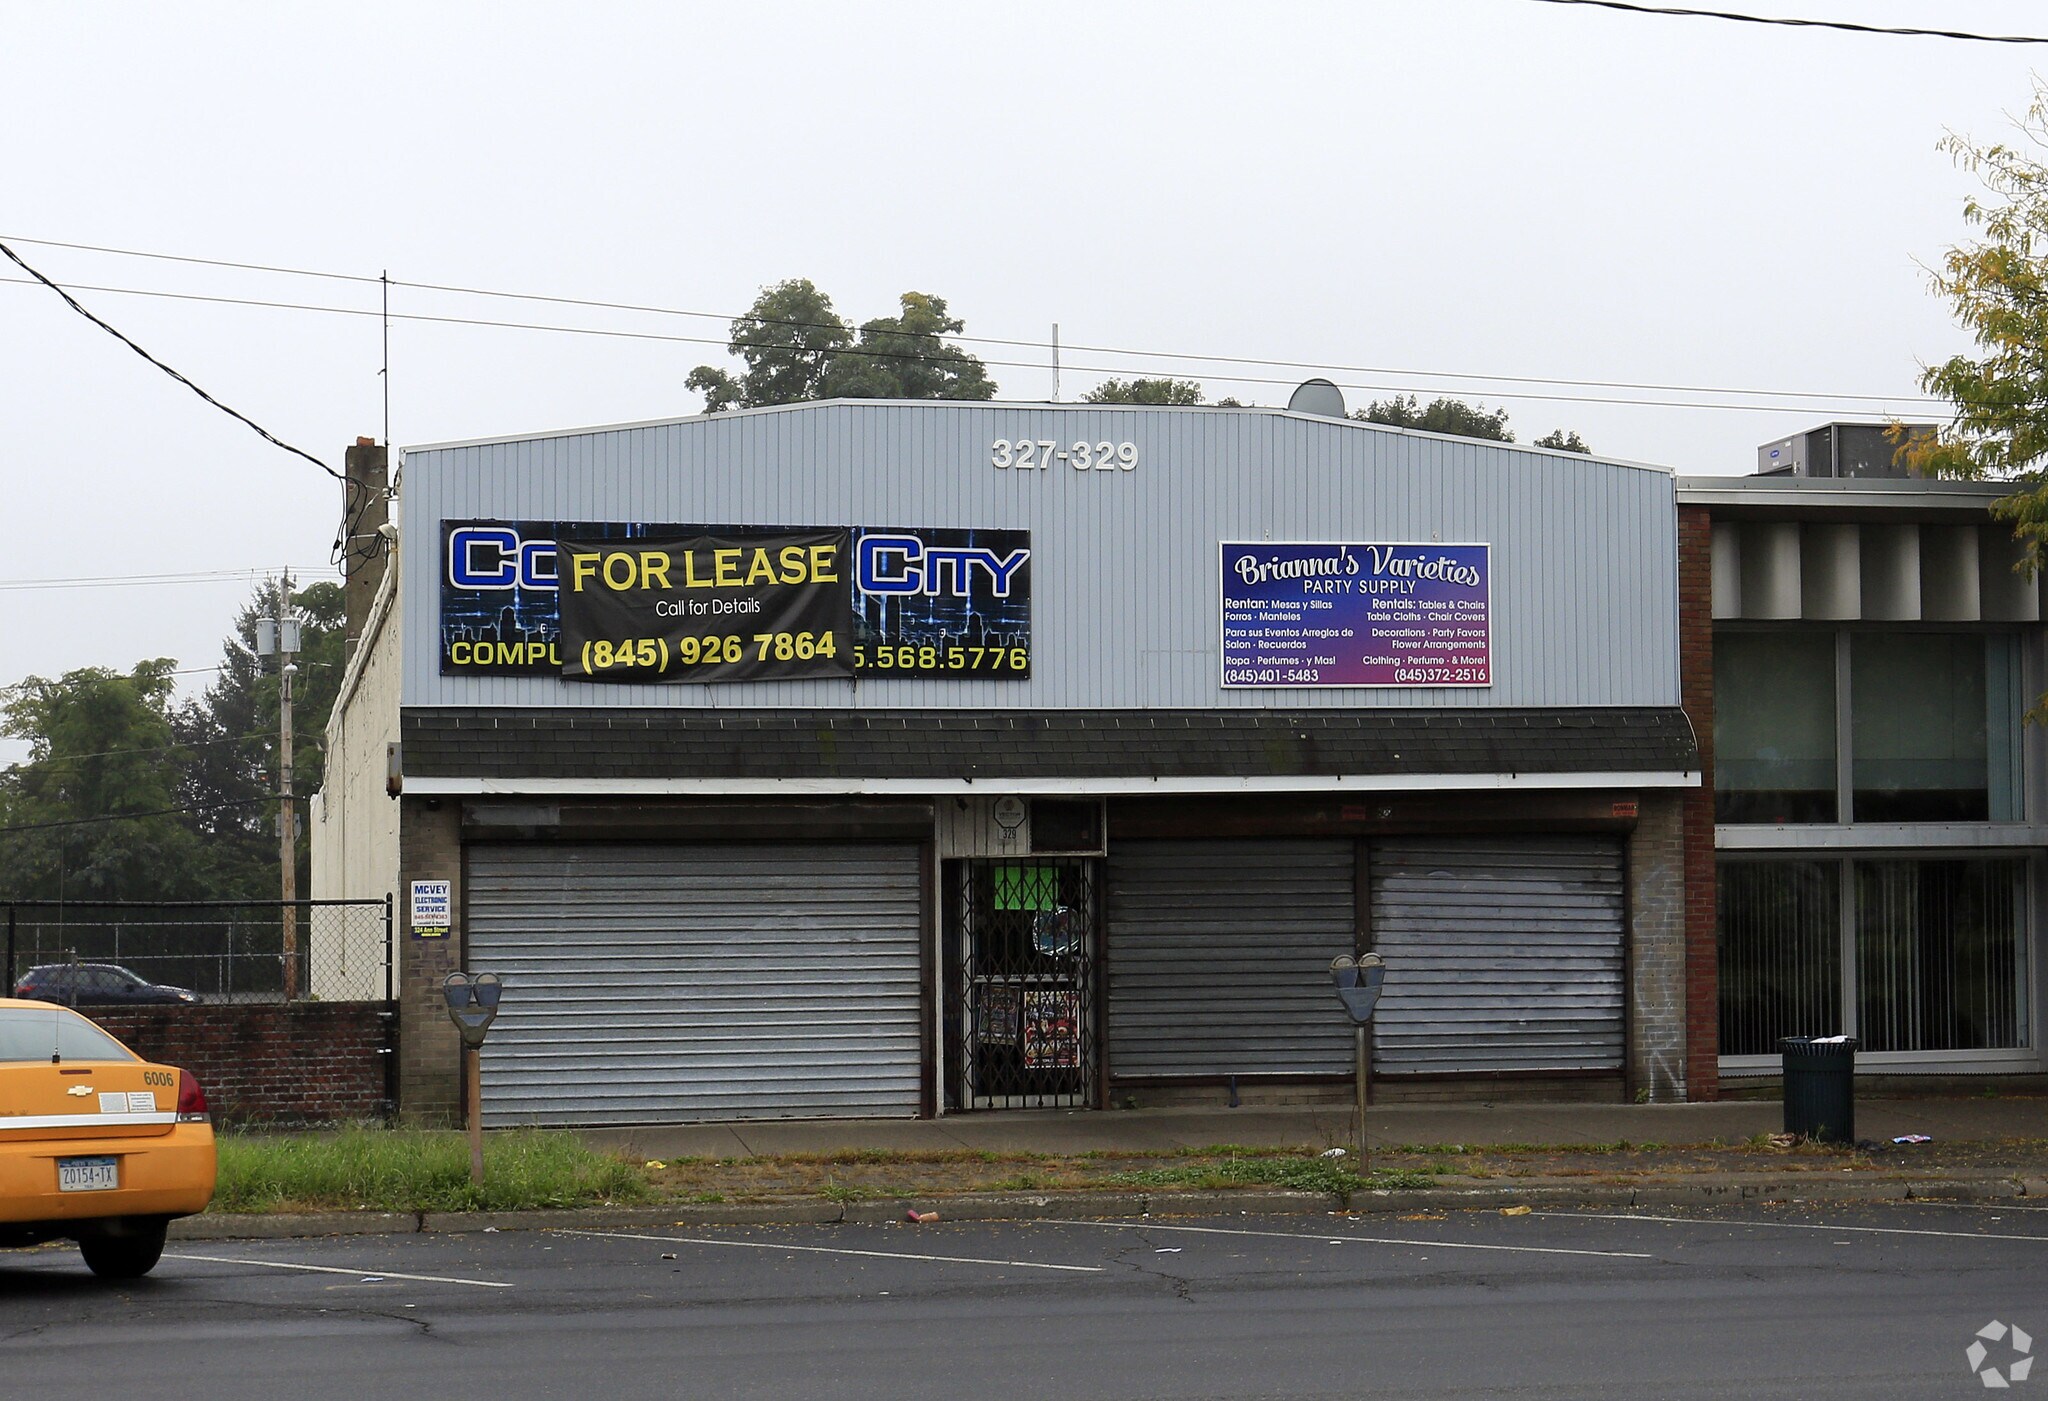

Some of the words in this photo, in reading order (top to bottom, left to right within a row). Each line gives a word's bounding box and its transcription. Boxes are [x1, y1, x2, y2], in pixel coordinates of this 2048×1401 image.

[991, 439, 1139, 471] 327-329
[572, 551, 672, 592] FOR
[684, 544, 838, 588] LEASE
[1234, 546, 1360, 585] Brianna's
[1366, 546, 1480, 586] Varieties
[1304, 580, 1353, 594] PARTY
[1359, 580, 1416, 594] SUPPLY
[655, 600, 685, 617] Call
[688, 599, 708, 616] for
[712, 598, 760, 615] Details
[1225, 598, 1269, 609] Rentan:
[1271, 600, 1300, 609] Mesas
[1302, 602, 1309, 611] y
[1310, 600, 1333, 609] Sillas
[1372, 598, 1416, 609] Rentals:
[1419, 600, 1447, 609] Tables
[1448, 600, 1455, 609] &
[1457, 600, 1485, 609] Chairs
[1225, 612, 1252, 621] Forros
[1260, 612, 1301, 621] Manteles
[1367, 612, 1391, 621] Table
[1393, 612, 1421, 621] Cloths
[1428, 612, 1452, 621] Chair
[1454, 612, 1485, 621] Covers
[1225, 628, 1247, 637] Para
[1248, 629, 1263, 637] sus
[1265, 628, 1300, 637] Eventos
[1302, 628, 1339, 639] Arreglos
[1341, 628, 1354, 637] de
[1372, 628, 1426, 637] Decorations
[1432, 628, 1455, 638] Party
[1457, 628, 1486, 637] Favors
[1225, 640, 1251, 649] Salon
[1258, 640, 1307, 649] Recuerdos
[1392, 640, 1421, 649] Flower
[1423, 640, 1486, 651] Arrangements
[581, 638, 669, 675] (845)
[680, 635, 742, 664] 926
[753, 631, 836, 662] 7864
[1225, 656, 1250, 667] Ropa
[1257, 656, 1299, 665] Perfumes
[1306, 657, 1313, 667] y
[1363, 656, 1401, 666] Clothing
[1407, 656, 1445, 665] Perfume
[1451, 656, 1459, 665] &
[1225, 669, 1319, 683] (845)401-5483
[1394, 669, 1486, 682] (845)372-2516
[1003, 829, 1016, 839] 329
[415, 885, 447, 894] MCVEY
[144, 1071, 174, 1087] 6006
